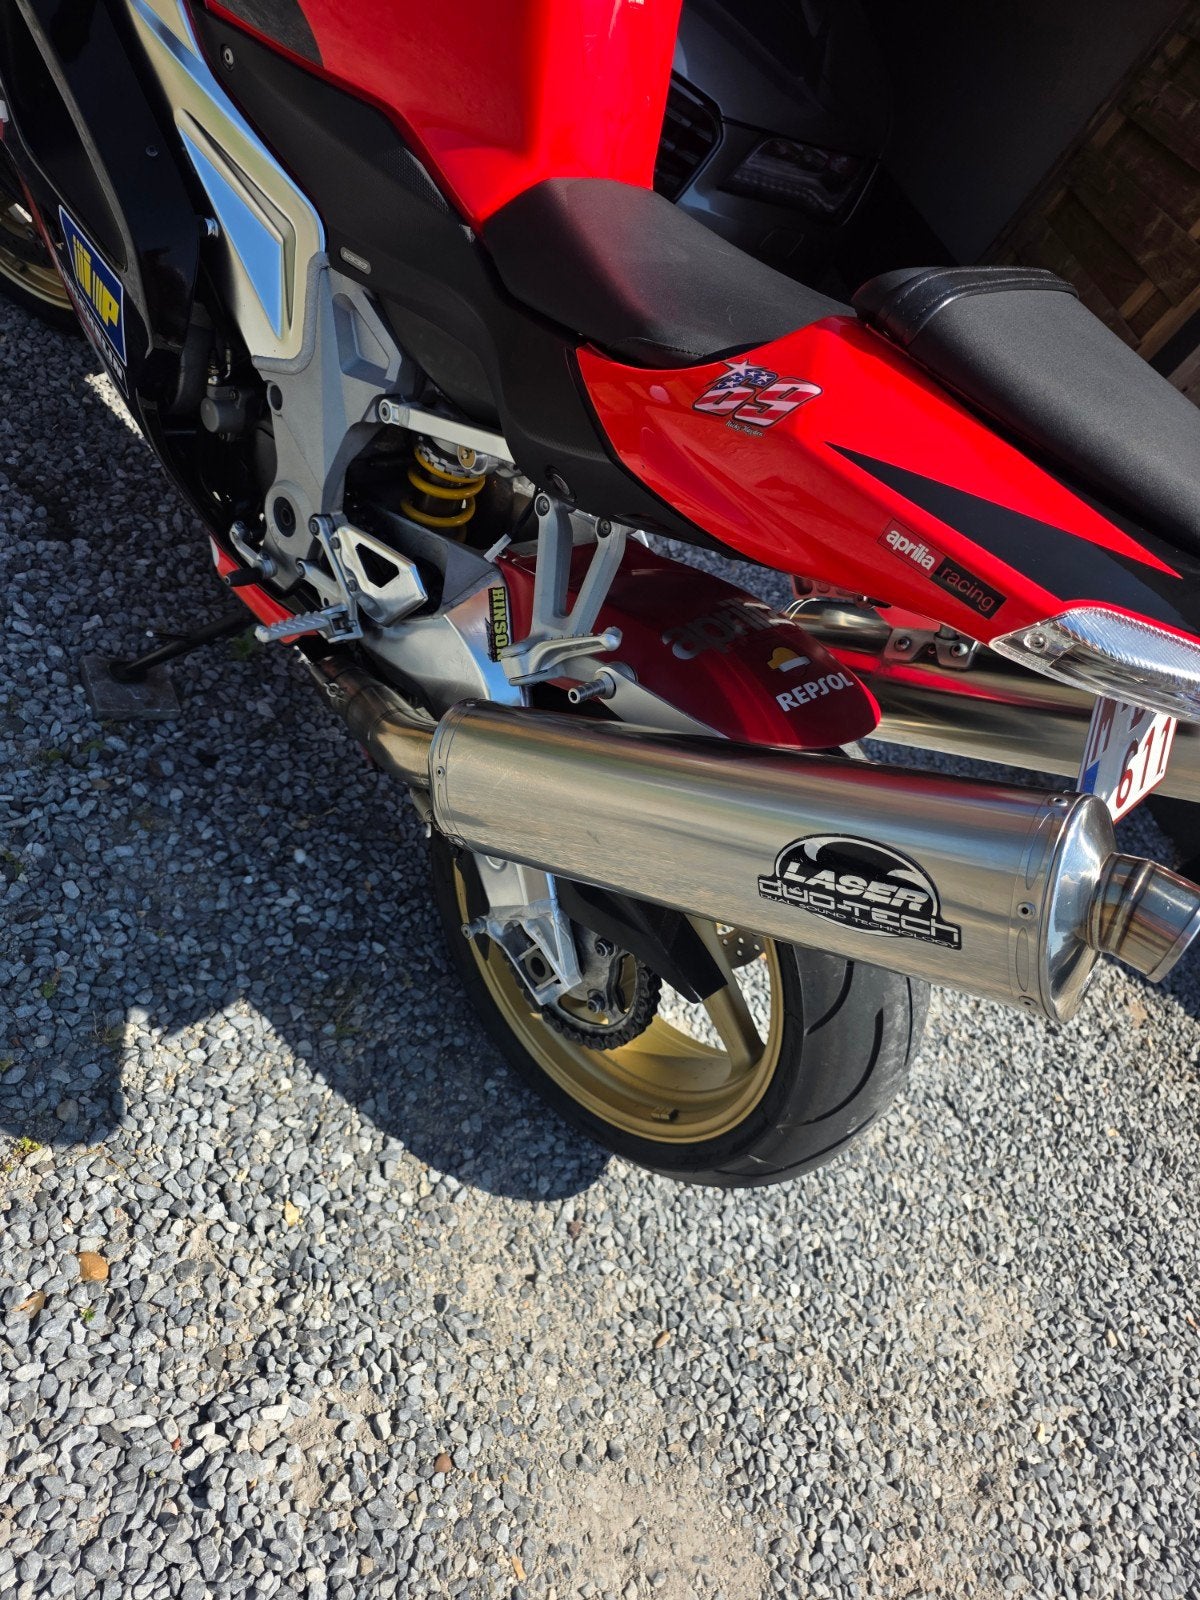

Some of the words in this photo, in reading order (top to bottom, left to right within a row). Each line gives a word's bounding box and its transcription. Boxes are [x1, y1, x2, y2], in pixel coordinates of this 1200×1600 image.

[692, 360, 822, 427] 69
[886, 530, 935, 571] aprilia
[940, 567, 995, 612] racing
[775, 672, 854, 712] REPSOL
[1115, 715, 1172, 809] 611
[783, 861, 930, 912] LASER
[760, 892, 795, 907] DUAL
[799, 903, 847, 919] SOUND
[851, 916, 959, 948] TECHNOLOGY
